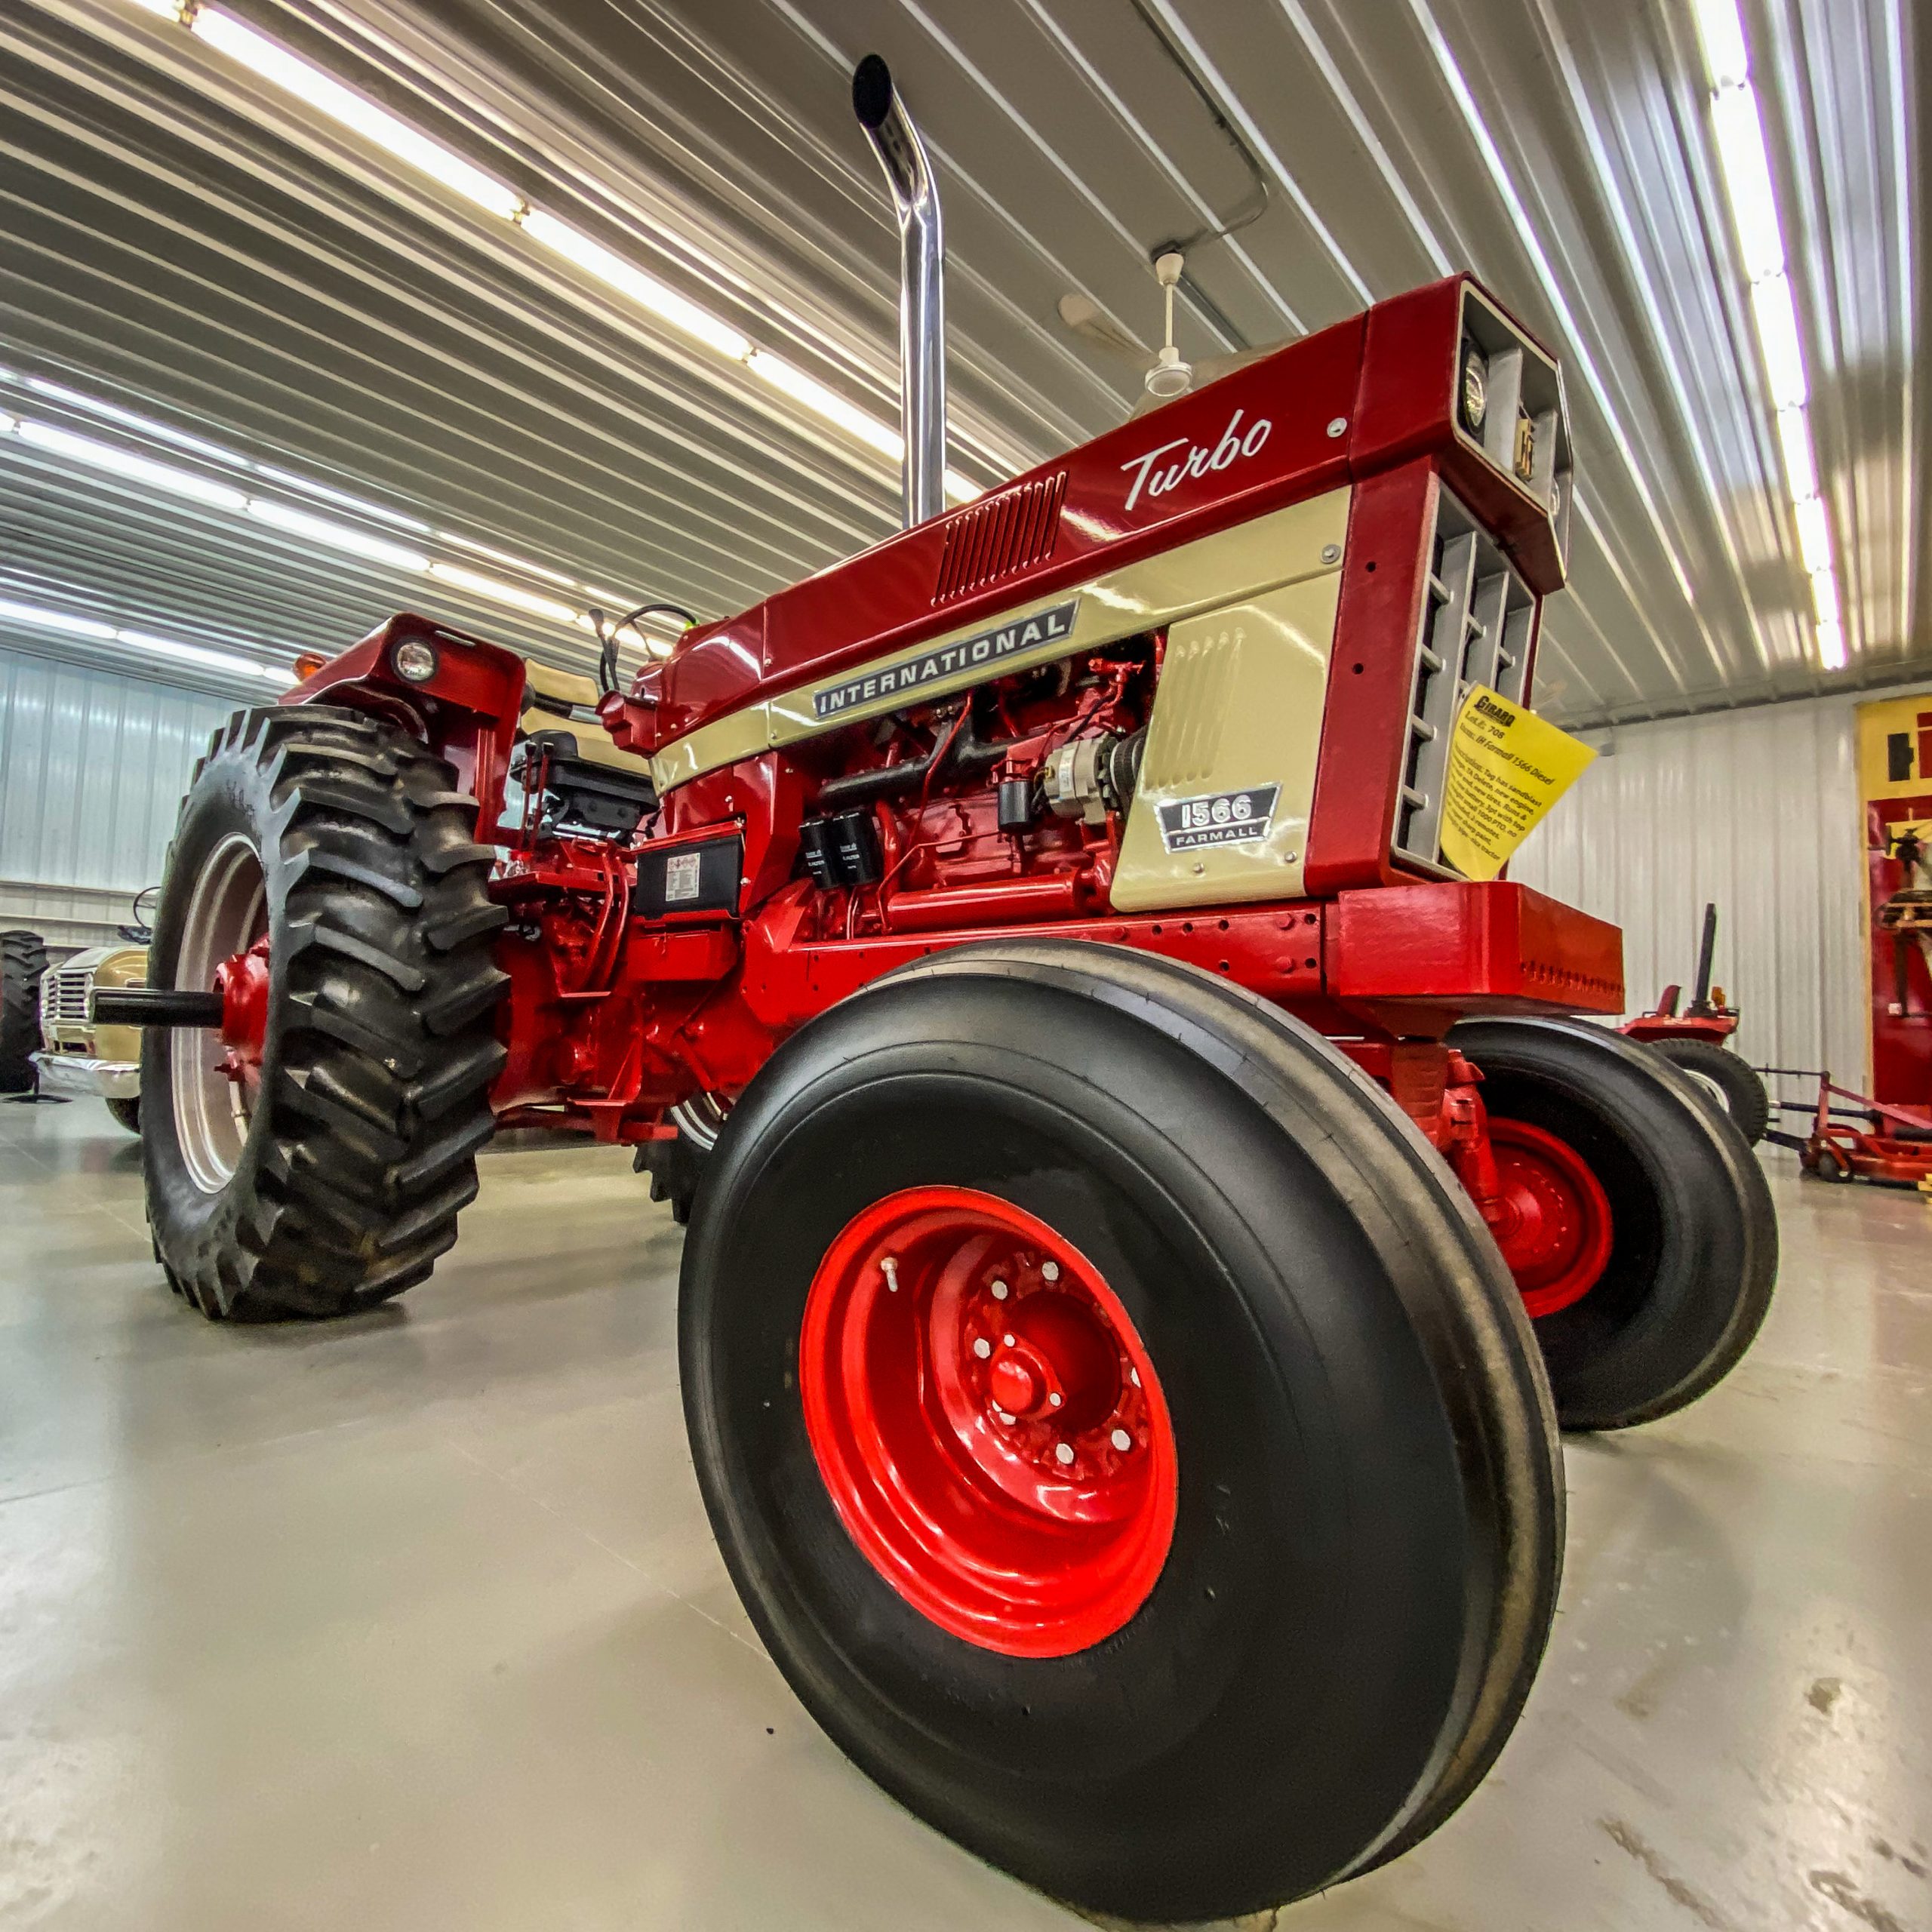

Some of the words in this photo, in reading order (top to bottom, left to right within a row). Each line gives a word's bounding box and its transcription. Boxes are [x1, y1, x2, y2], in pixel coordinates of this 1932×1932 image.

[1120, 409, 1272, 511] Turbo
[820, 614, 1066, 713] INTERNATIONAL
[1487, 724, 1505, 740] 708
[1475, 734, 1486, 746] IH
[1483, 739, 1514, 761] Farmall
[1511, 756, 1532, 772] 1566
[1529, 767, 1555, 786] Diesel
[1472, 772, 1495, 791] Delete,
[1494, 788, 1509, 799] new
[1509, 797, 1535, 815] engine,
[1472, 785, 1486, 796] new
[1503, 803, 1520, 817] Runs
[1519, 813, 1527, 821] &
[1482, 768, 1497, 781] Tag
[1495, 776, 1509, 787] has
[1507, 785, 1543, 808] sandblast
[1181, 794, 1252, 829] 1566
[1484, 804, 1497, 815] 3pt
[1497, 811, 1514, 823] with
[1512, 820, 1525, 832] top
[1176, 826, 1258, 846] FARMALL
[1506, 829, 1517, 838] no
[1480, 844, 1500, 861] tractor
